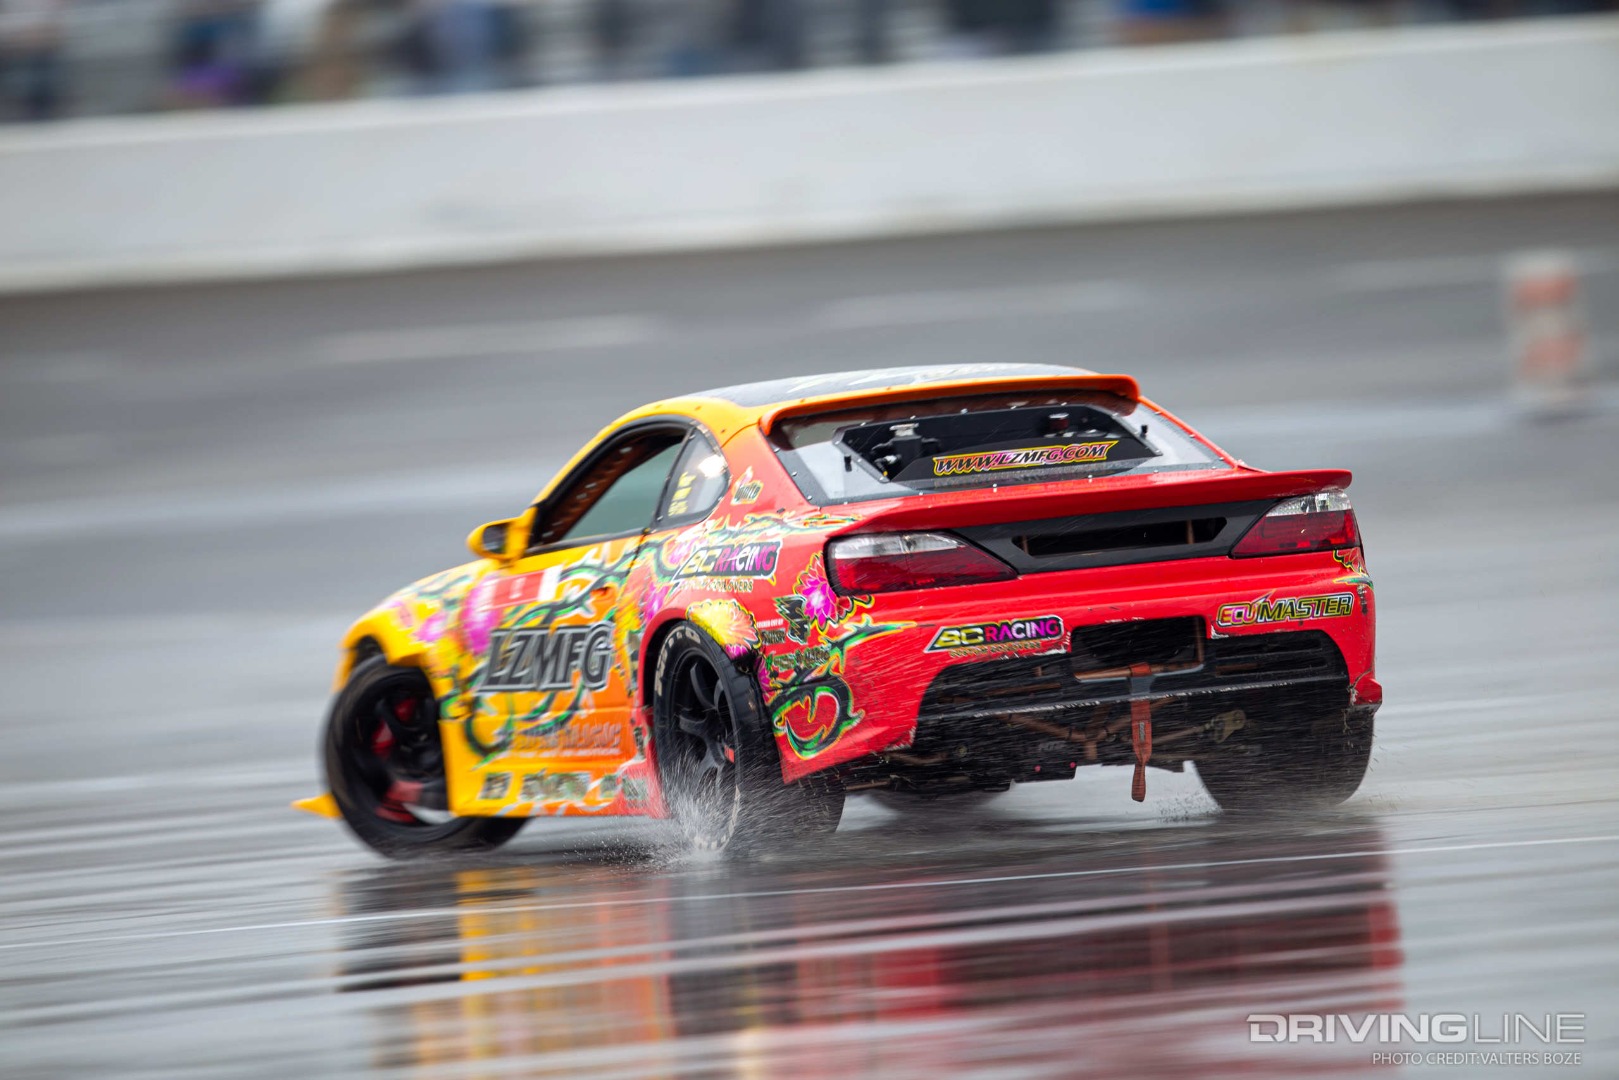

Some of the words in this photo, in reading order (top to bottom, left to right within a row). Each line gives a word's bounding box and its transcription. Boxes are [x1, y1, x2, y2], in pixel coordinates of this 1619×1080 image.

[936, 444, 1107, 471] WWW.LZMFG.COM
[714, 544, 777, 573] RACING
[984, 618, 1059, 643] RACING
[478, 622, 613, 690] LZMFG
